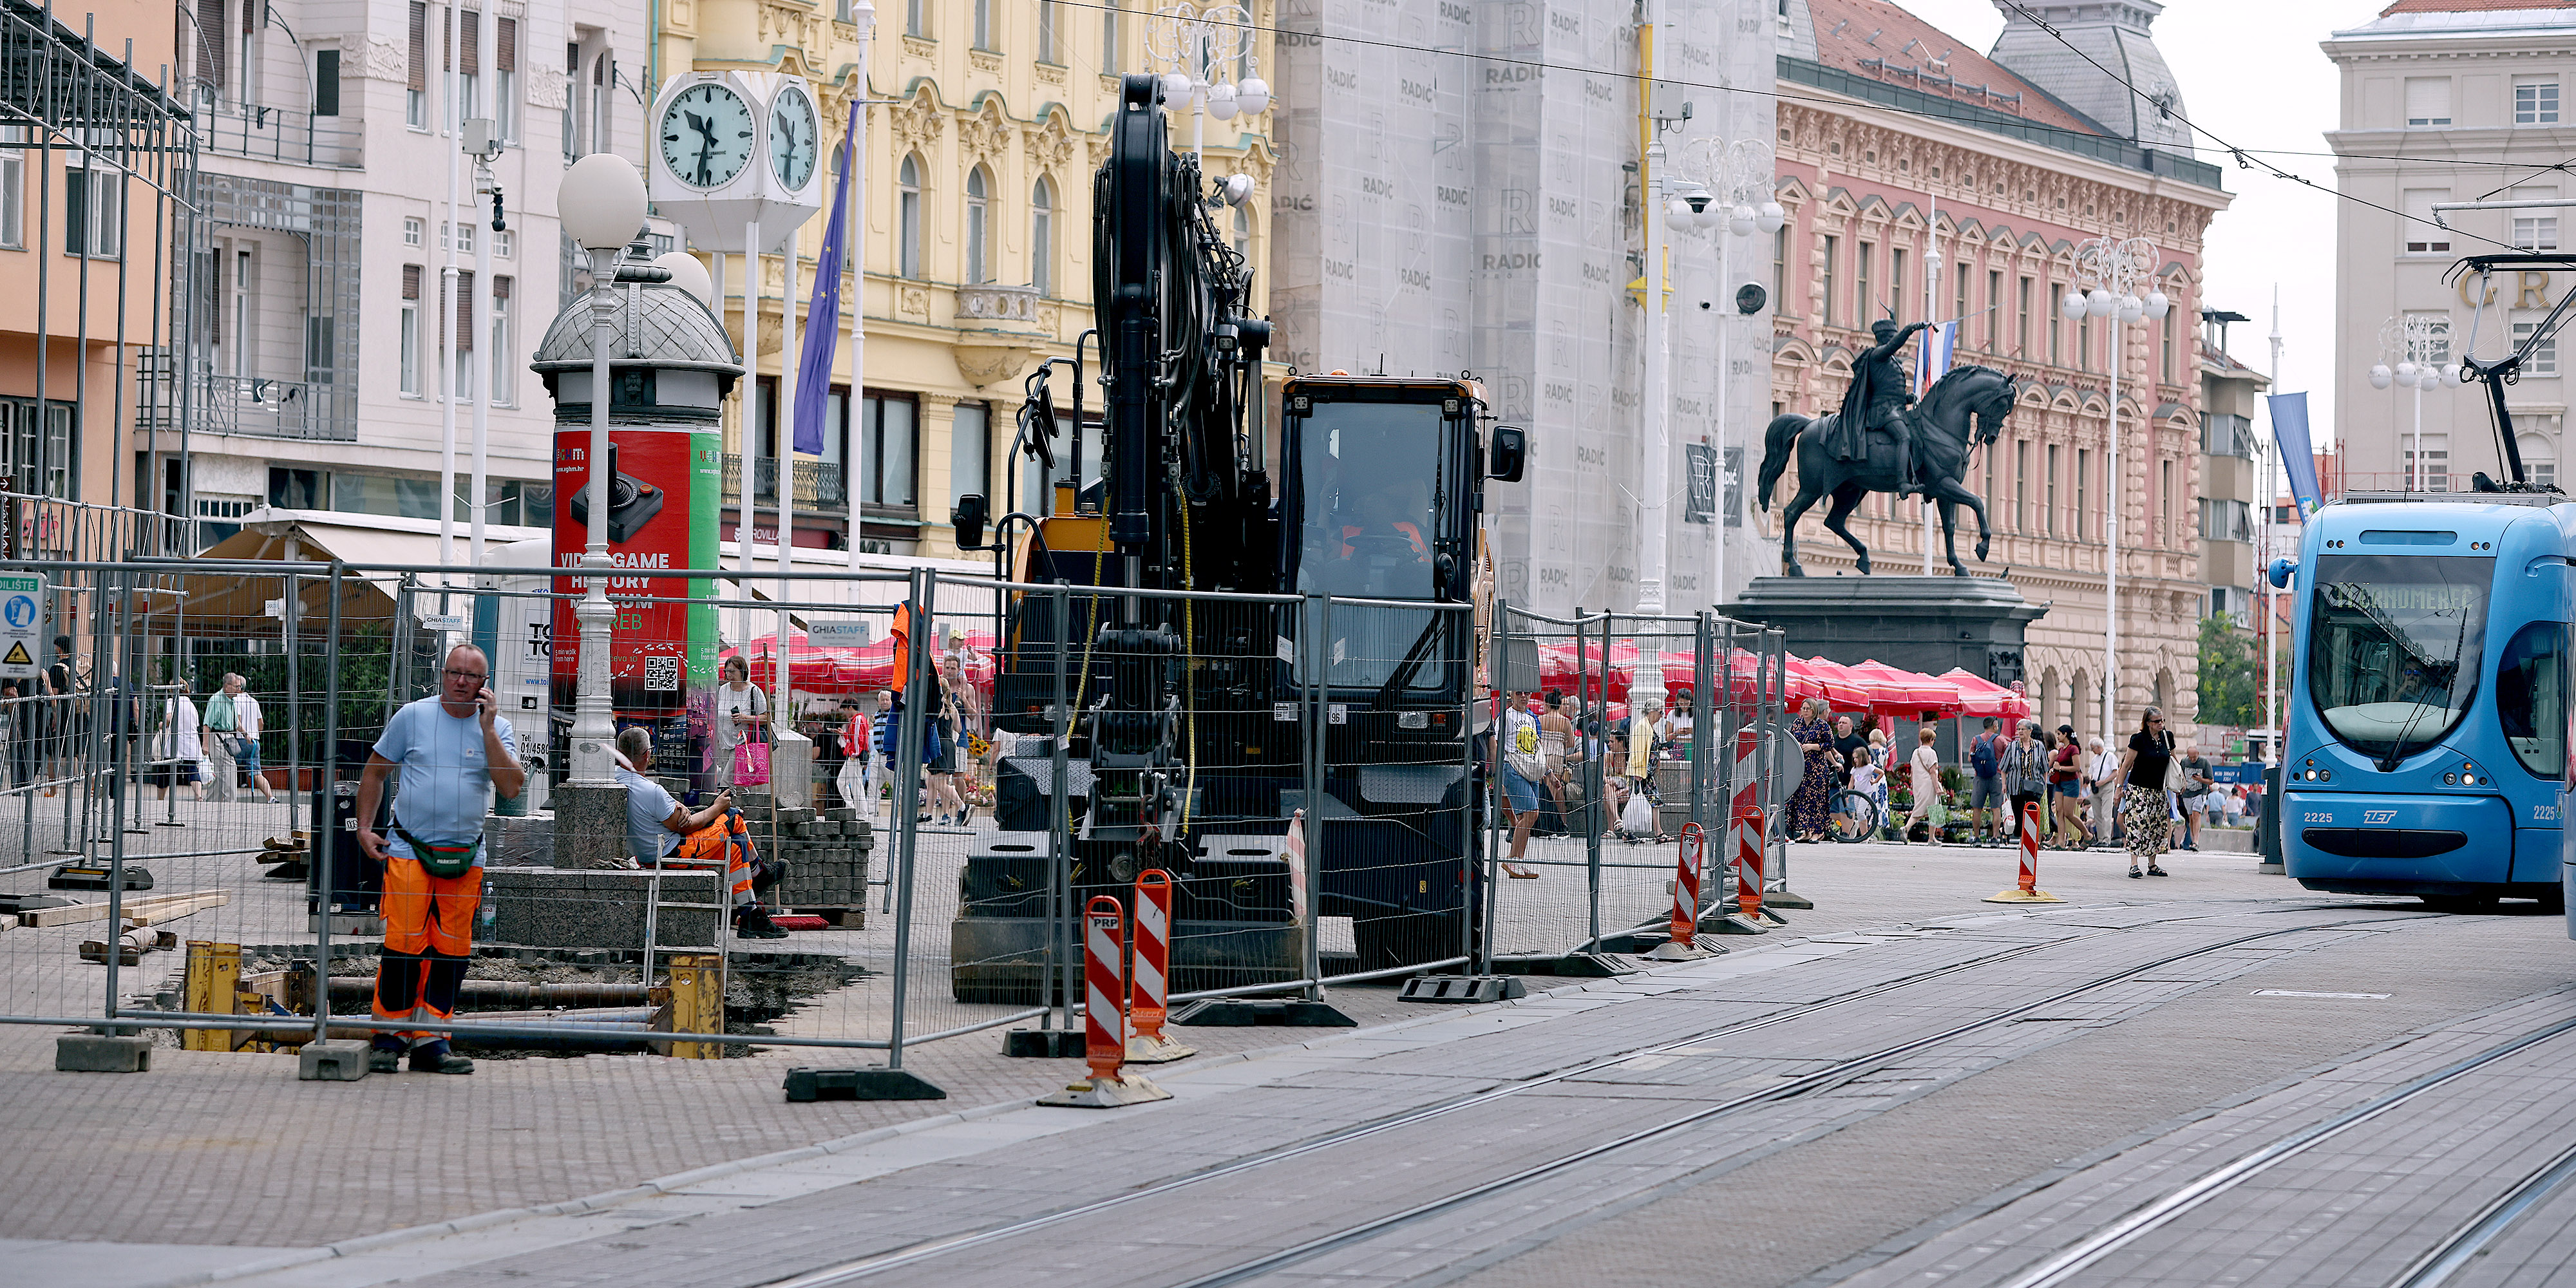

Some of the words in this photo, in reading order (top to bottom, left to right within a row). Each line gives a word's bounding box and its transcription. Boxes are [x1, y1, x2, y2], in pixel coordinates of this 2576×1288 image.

[1440, 1, 1471, 25] RADIĆ
[1552, 12, 1580, 35] RADIĆ
[1274, 27, 1321, 47] ADIĆ
[1327, 66, 1356, 90] RADIĆ
[1401, 79, 1433, 104] RADIĆ
[1586, 79, 1613, 102] RADIĆ
[1363, 177, 1394, 200] RADIĆ
[1437, 185, 1468, 206] RADIĆ
[1549, 197, 1576, 218] RADIĆ
[1325, 258, 1354, 281] RADIĆ
[1401, 269, 1430, 291] RADIĆ
[1583, 261, 1610, 284] RADIĆ
[1545, 384, 1573, 403] RADIĆ
[1613, 387, 1638, 408] RADIĆ
[1677, 397, 1701, 416] RADIĆ
[1578, 446, 1605, 467] RADIĆ
[1705, 526, 1730, 547] RAĆ
[612, 553, 669, 568] GAME
[1541, 568, 1568, 587] RADIĆ
[1608, 565, 1634, 584] RADIĆ
[1672, 573, 1696, 591] RADIĆ
[813, 625, 866, 634] GHIASTAFF
[1332, 712, 1340, 723] 96
[2304, 812, 2333, 823] 2225
[2362, 810, 2398, 824] ZET
[2533, 805, 2555, 821] 2225
[1094, 918, 1118, 927] PRP
